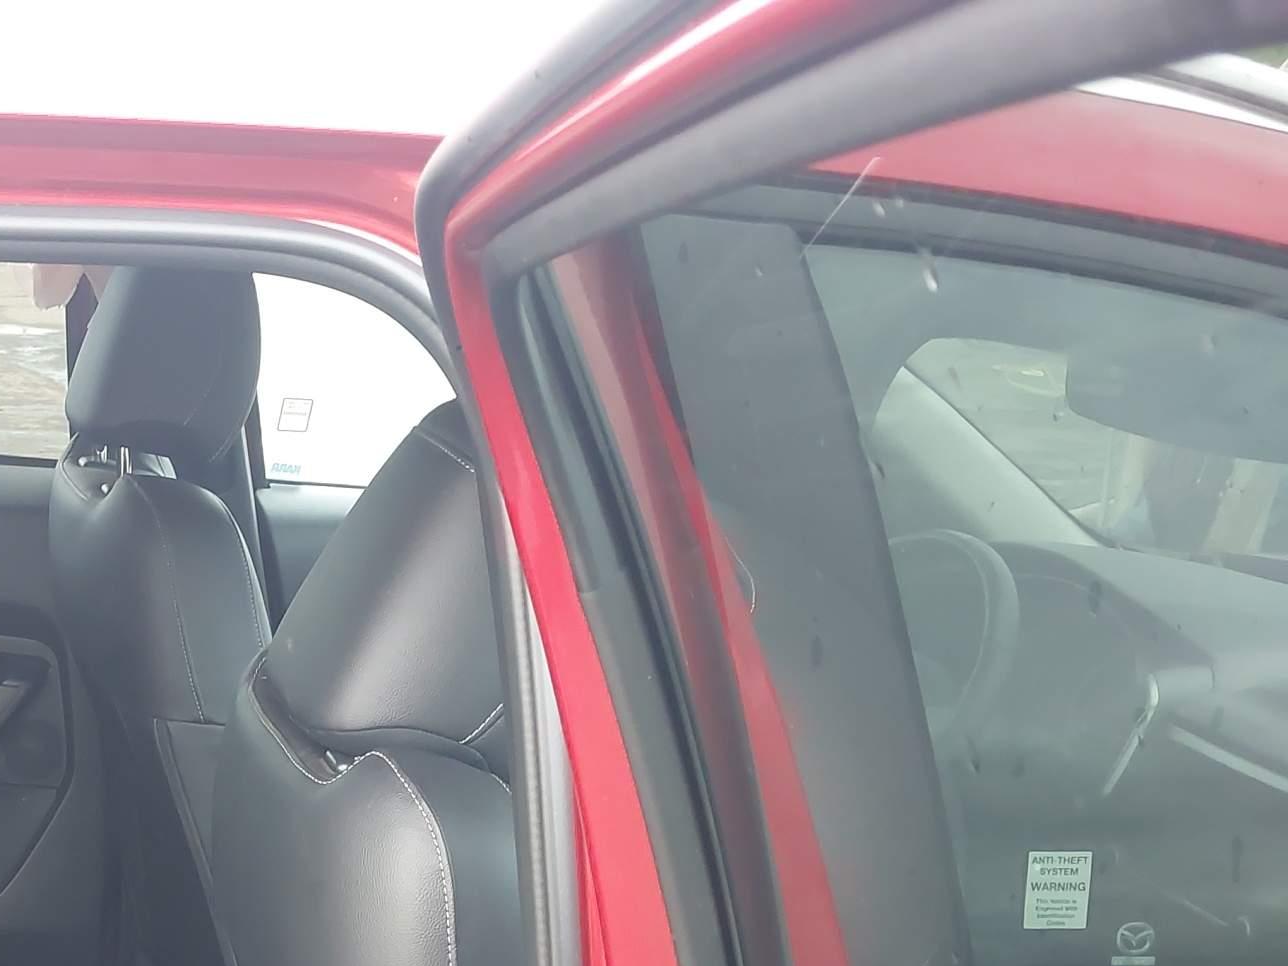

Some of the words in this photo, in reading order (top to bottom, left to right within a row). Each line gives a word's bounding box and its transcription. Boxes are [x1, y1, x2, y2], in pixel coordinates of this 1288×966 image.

[1032, 855, 1088, 865] ANTI-THEFT
[1040, 867, 1079, 876] SYSTEM
[1031, 882, 1086, 892] WARNING
